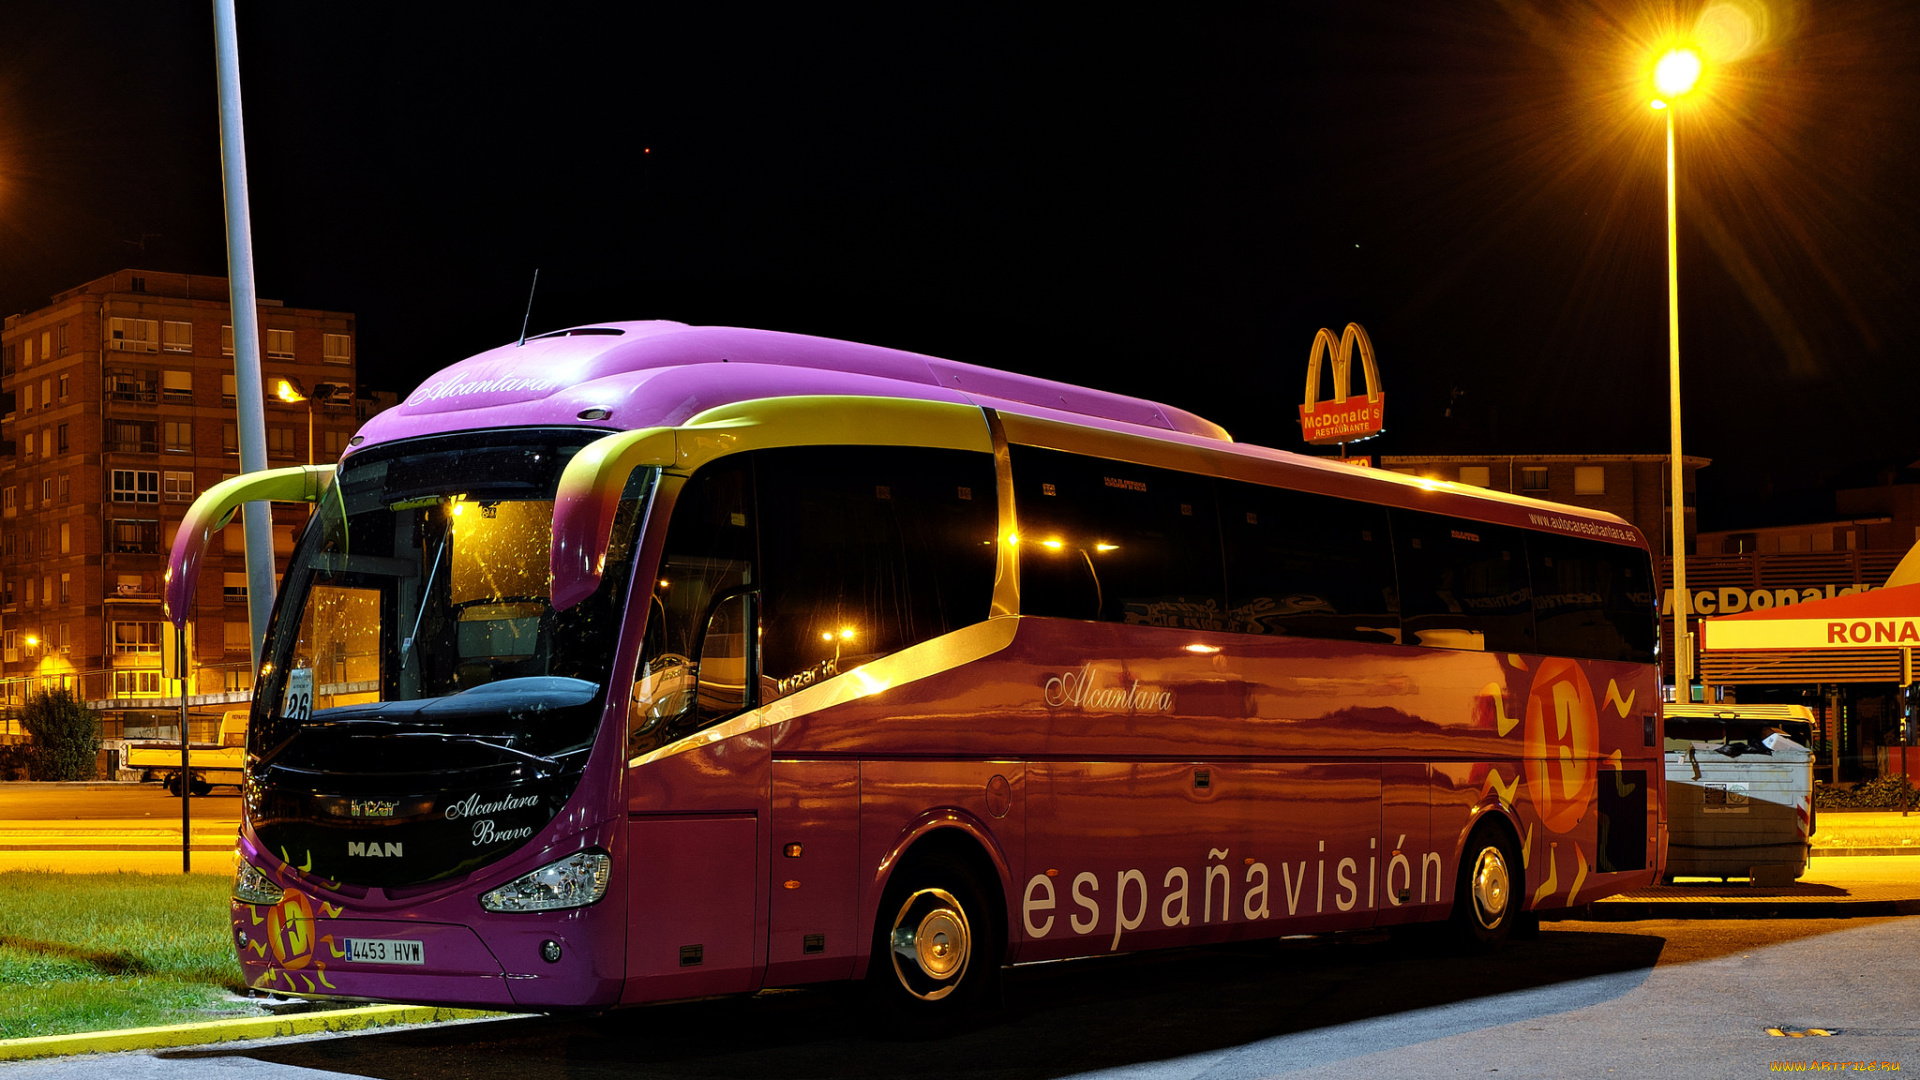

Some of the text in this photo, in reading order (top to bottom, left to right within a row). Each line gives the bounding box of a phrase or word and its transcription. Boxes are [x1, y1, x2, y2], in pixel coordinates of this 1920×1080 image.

[408, 371, 553, 407] Alcantara
[1304, 408, 1380, 430] McDonald's
[1315, 422, 1370, 437] RESTAURANTE
[1528, 513, 1637, 542] www.autocaresalcantara.es
[1661, 584, 1887, 615] McDonal'
[1827, 621, 1920, 644] RONA
[1044, 662, 1173, 711] Alcantara
[287, 693, 309, 720] 26
[445, 792, 539, 820] Alcantara
[471, 819, 533, 846] Bravo
[348, 841, 403, 857] MAN
[1022, 834, 1443, 951] españavisión
[353, 942, 386, 960] 4453
[394, 943, 420, 961] HVW
